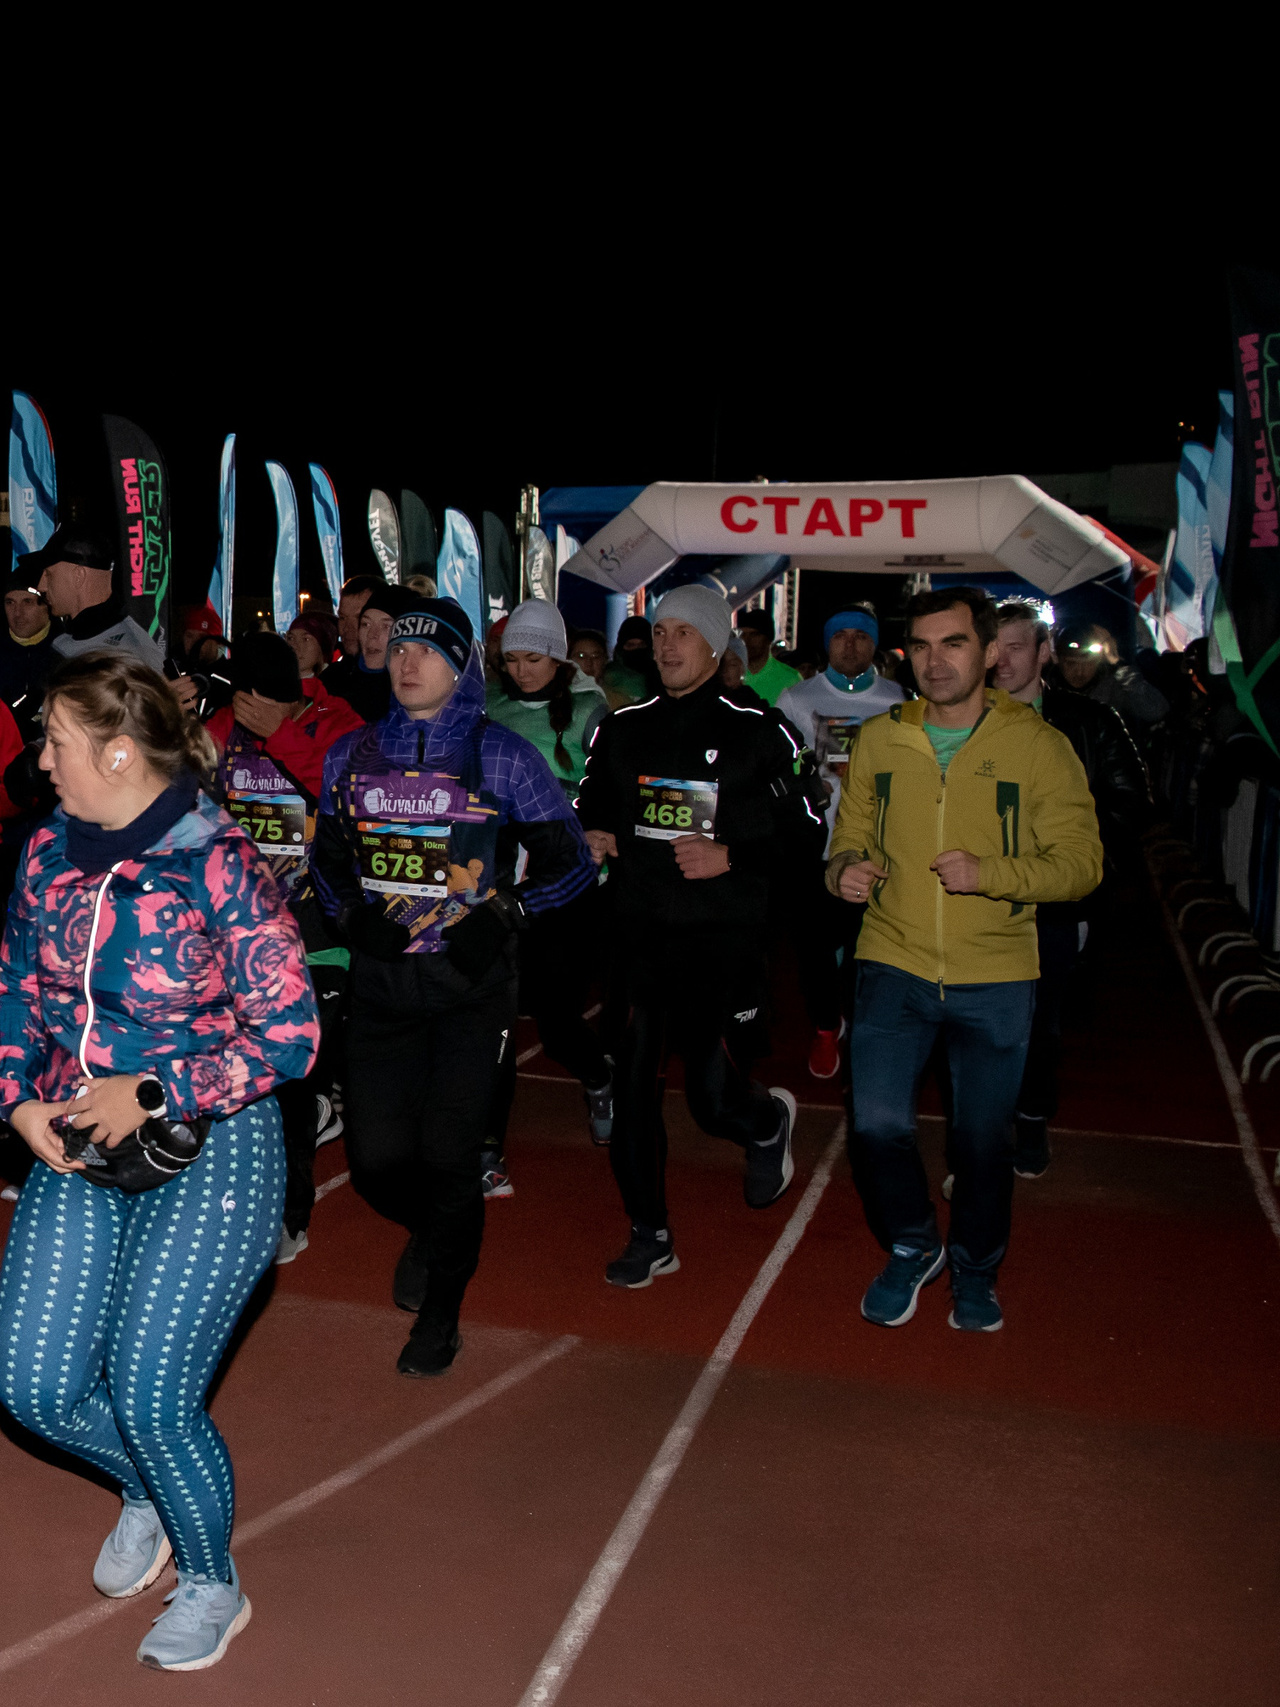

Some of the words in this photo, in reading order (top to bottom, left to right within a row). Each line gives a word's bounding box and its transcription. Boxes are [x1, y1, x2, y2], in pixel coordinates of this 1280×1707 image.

[720, 495, 927, 538] СТАРТ
[380, 799, 434, 815] KUVALDA
[643, 803, 693, 827] 468
[423, 841, 446, 850] 10km
[371, 852, 424, 879] 678
